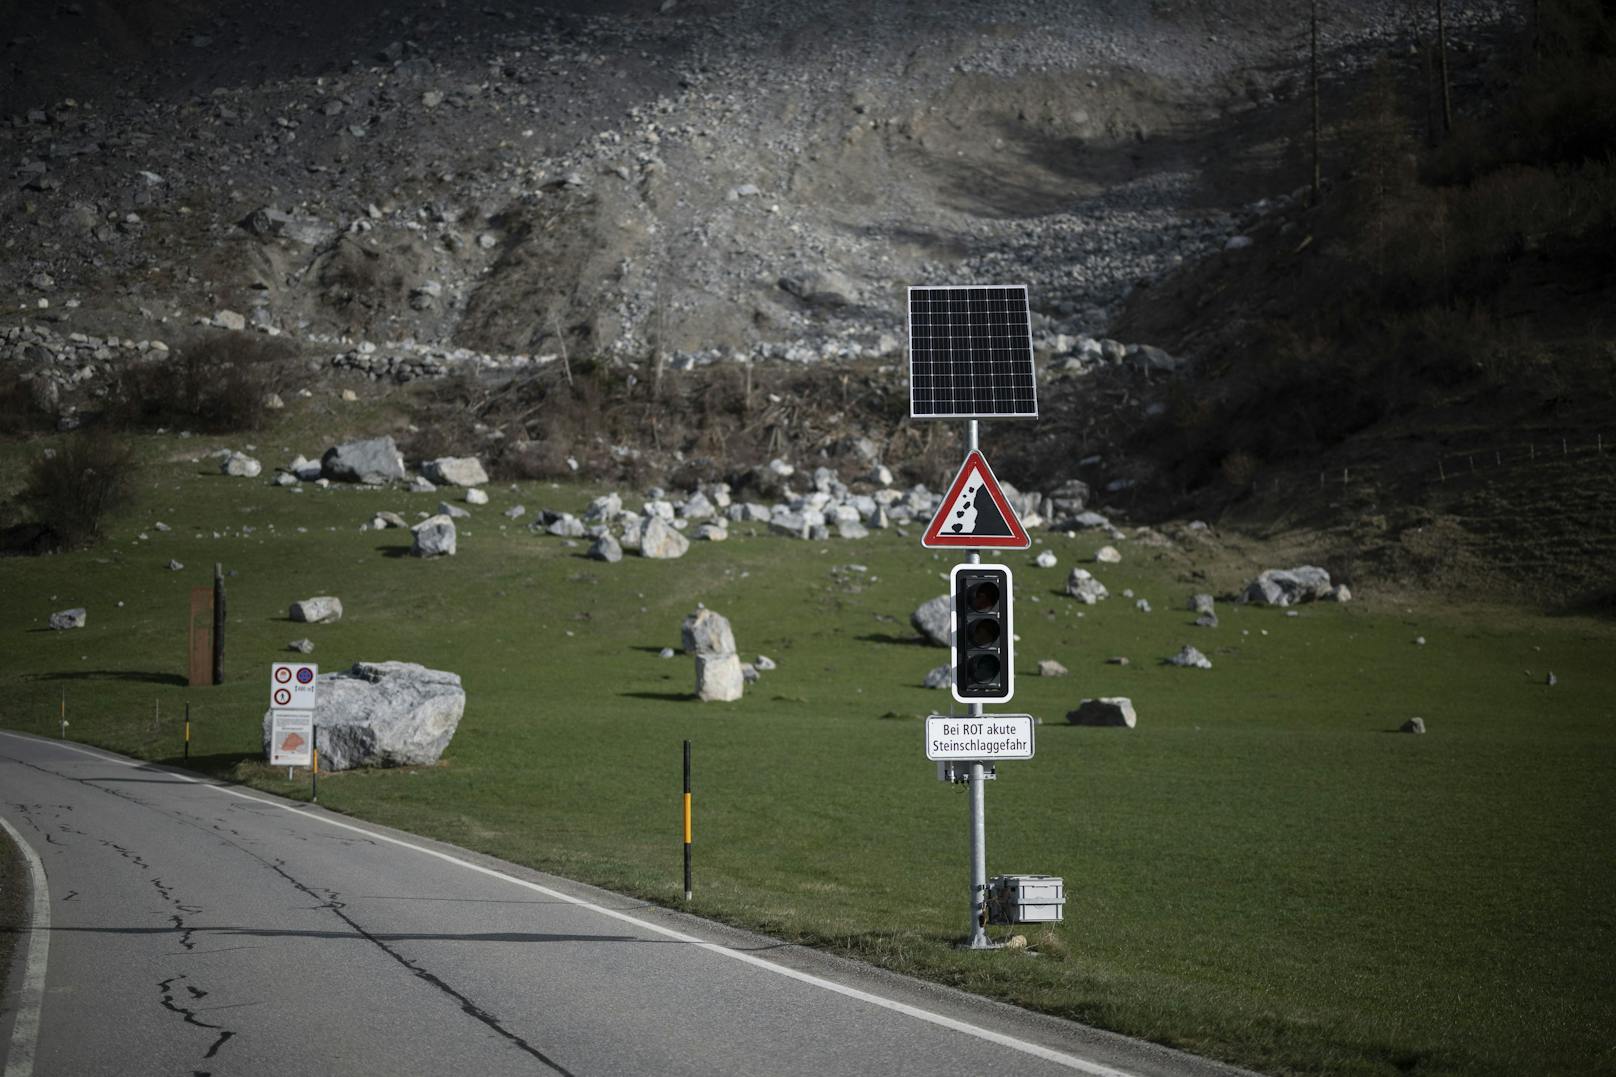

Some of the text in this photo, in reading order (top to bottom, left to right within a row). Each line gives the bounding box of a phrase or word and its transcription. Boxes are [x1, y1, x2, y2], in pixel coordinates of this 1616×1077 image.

[943, 723, 1016, 735] Bei ROT akute
[933, 739, 1027, 753] Steinschlaggefahr
